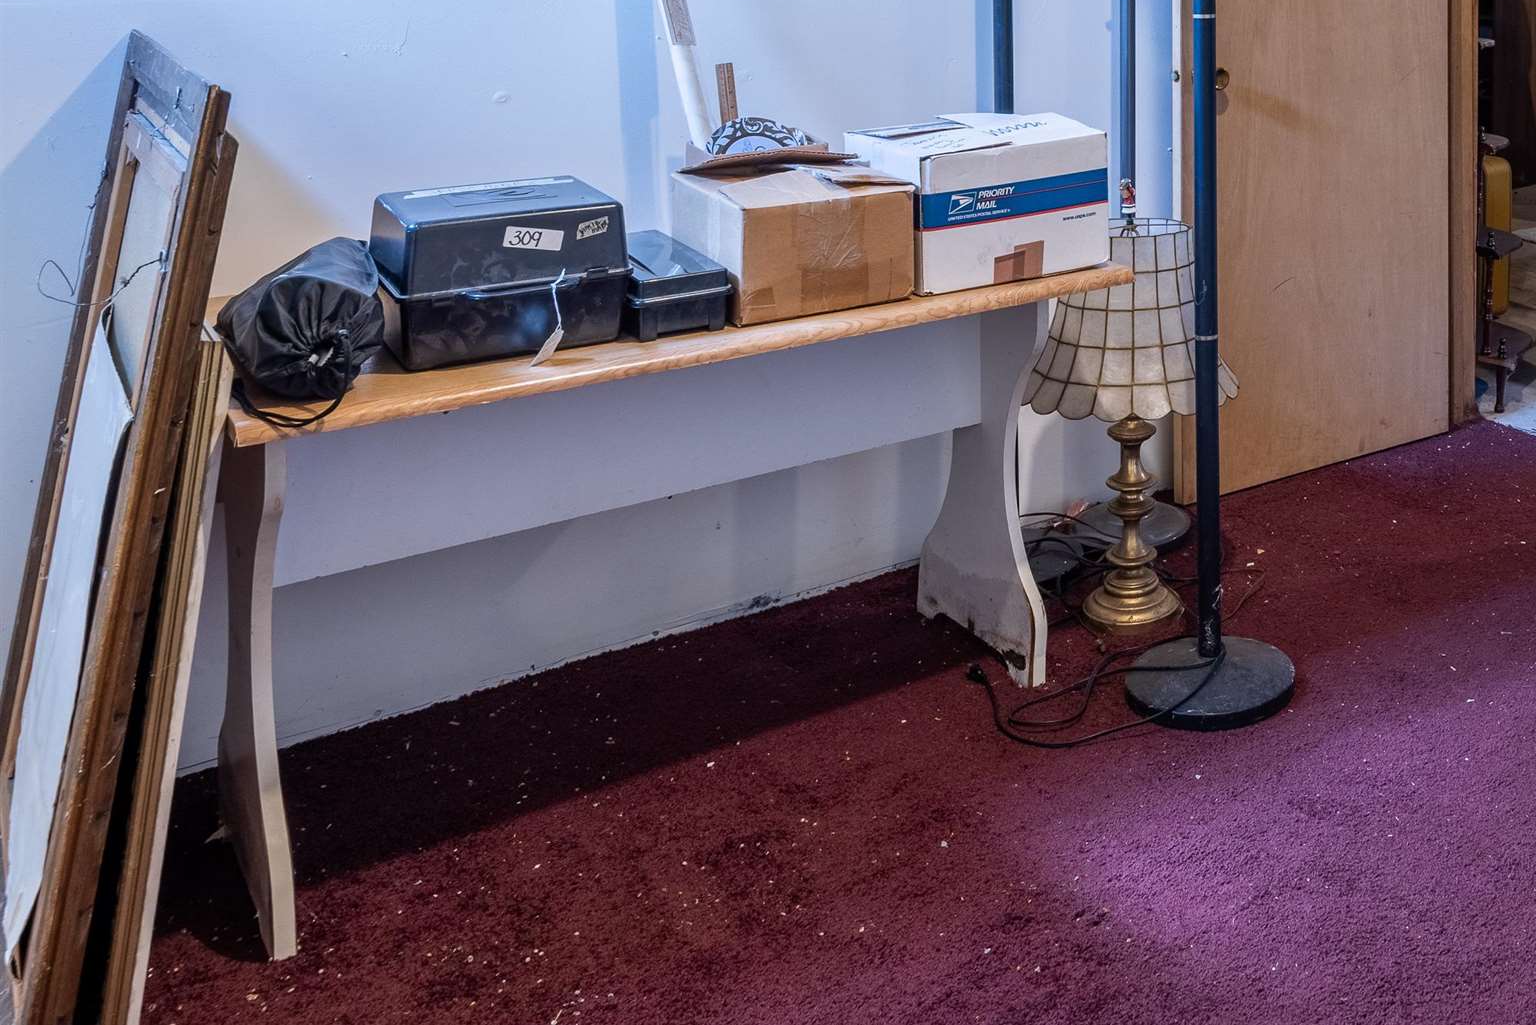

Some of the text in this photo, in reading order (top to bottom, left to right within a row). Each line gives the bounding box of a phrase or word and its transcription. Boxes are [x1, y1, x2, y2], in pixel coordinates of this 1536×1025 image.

[978, 186, 1015, 199] PRIORITY
[976, 201, 998, 210] MAIL
[509, 231, 542, 247] 309
